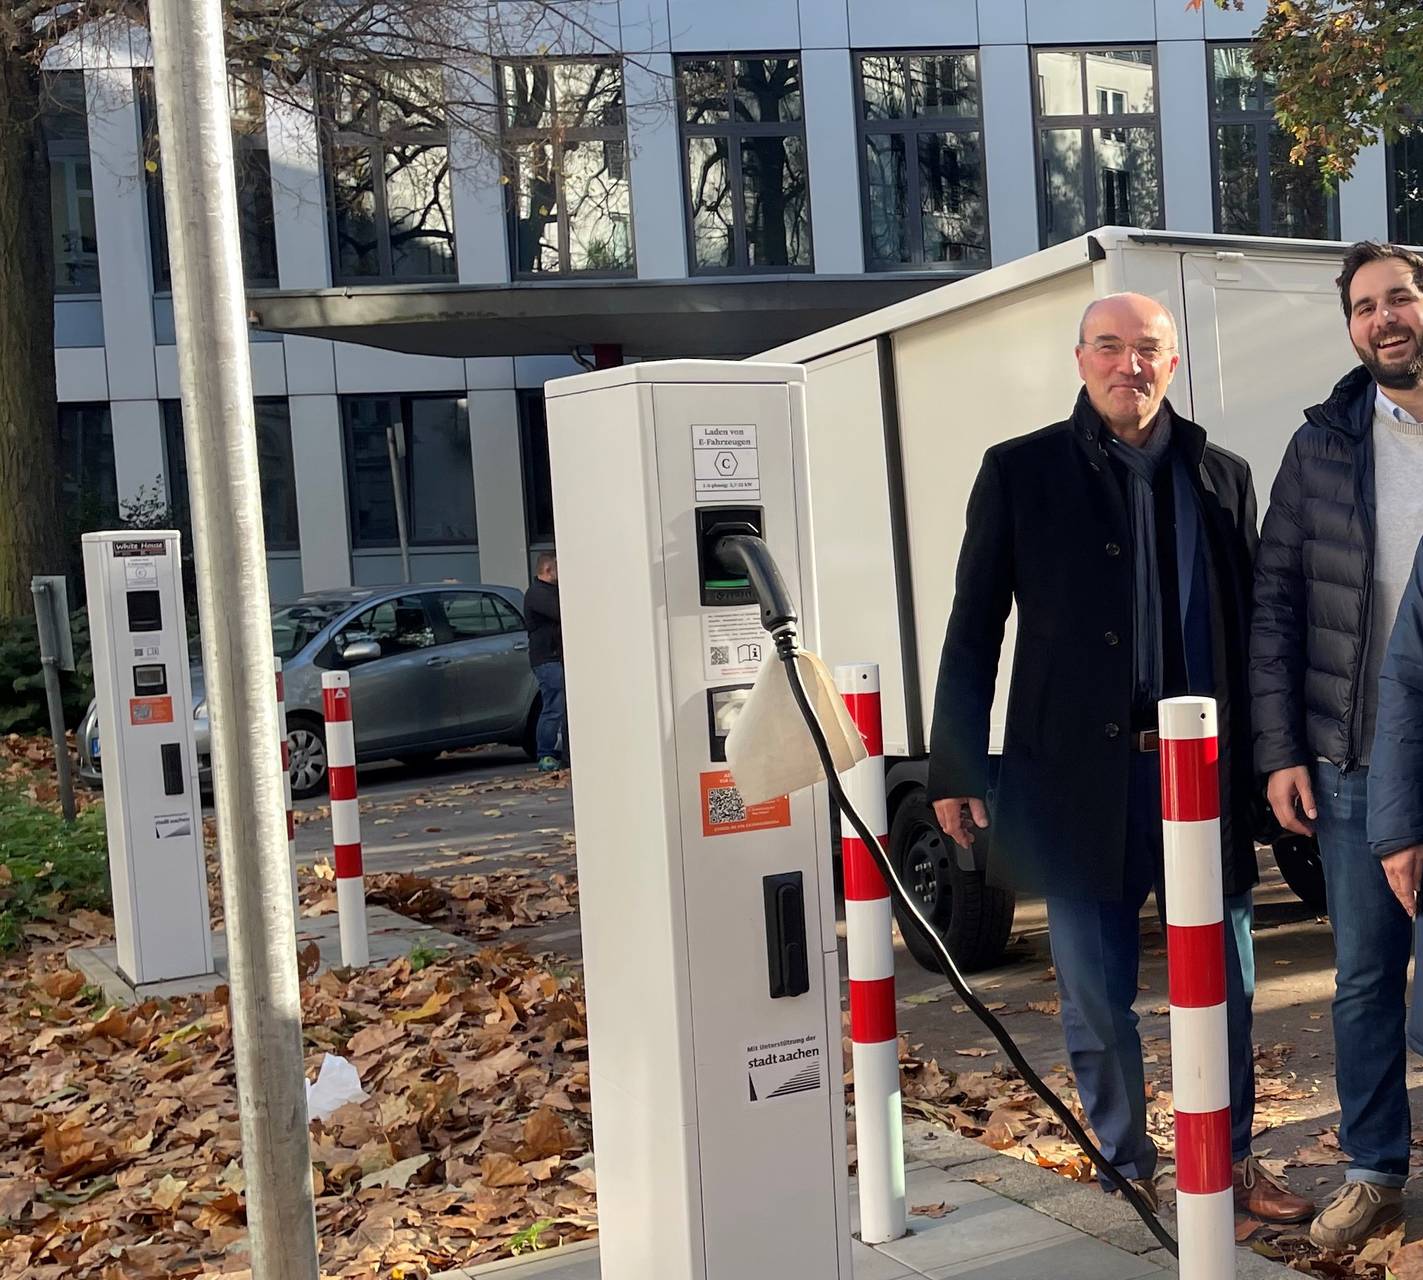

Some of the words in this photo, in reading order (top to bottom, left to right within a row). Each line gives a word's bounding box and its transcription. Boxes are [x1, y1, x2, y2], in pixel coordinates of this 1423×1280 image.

[704, 428, 728, 436] Laden
[698, 438, 751, 446] E-Fahrzeugen
[721, 458, 731, 469] C
[746, 1045, 758, 1053] Mit
[805, 1034, 817, 1042] der
[748, 1053, 778, 1069] stadt
[778, 1047, 820, 1063] aachen
